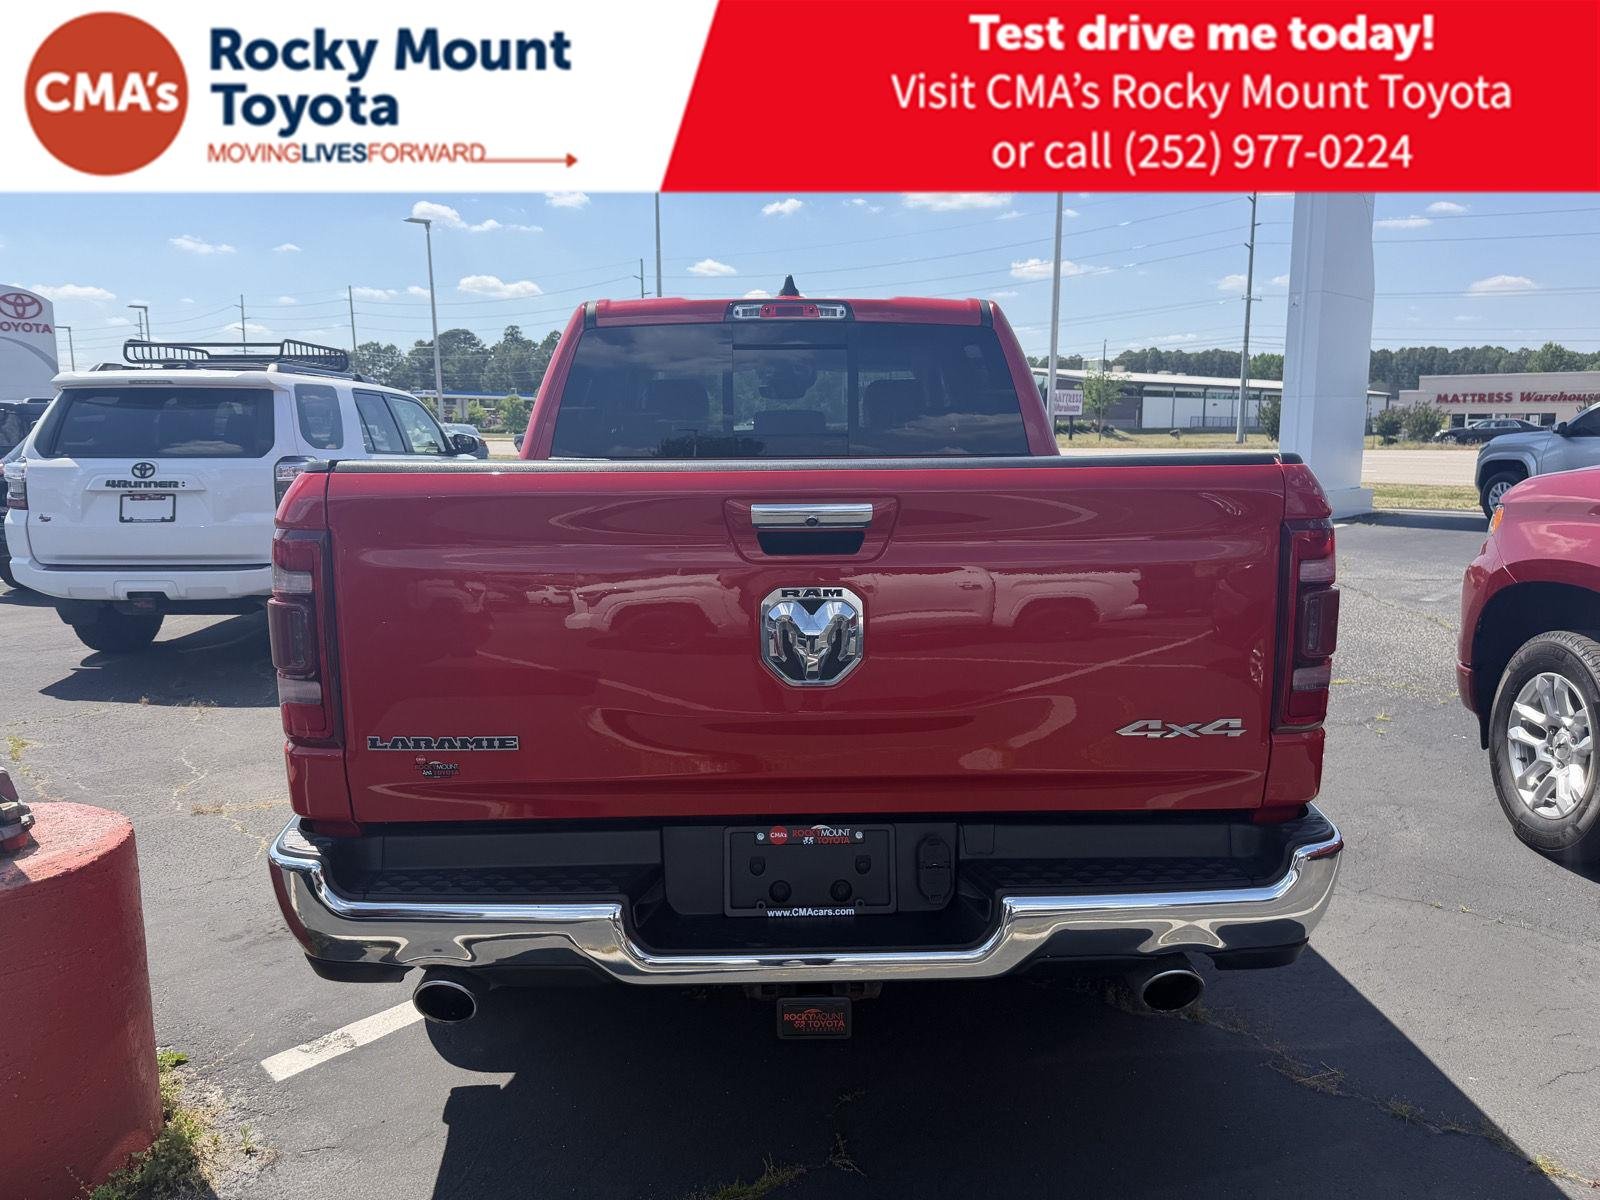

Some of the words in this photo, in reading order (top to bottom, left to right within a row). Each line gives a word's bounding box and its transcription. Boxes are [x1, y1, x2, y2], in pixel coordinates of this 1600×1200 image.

[0, 321, 52, 334] OYOTA
[1436, 392, 1513, 404] MATTRESS
[1520, 391, 1600, 402] Warehouse
[781, 589, 843, 597] RAM
[367, 736, 519, 750] LARAMIE
[767, 907, 855, 917] www.CMAcars.com
